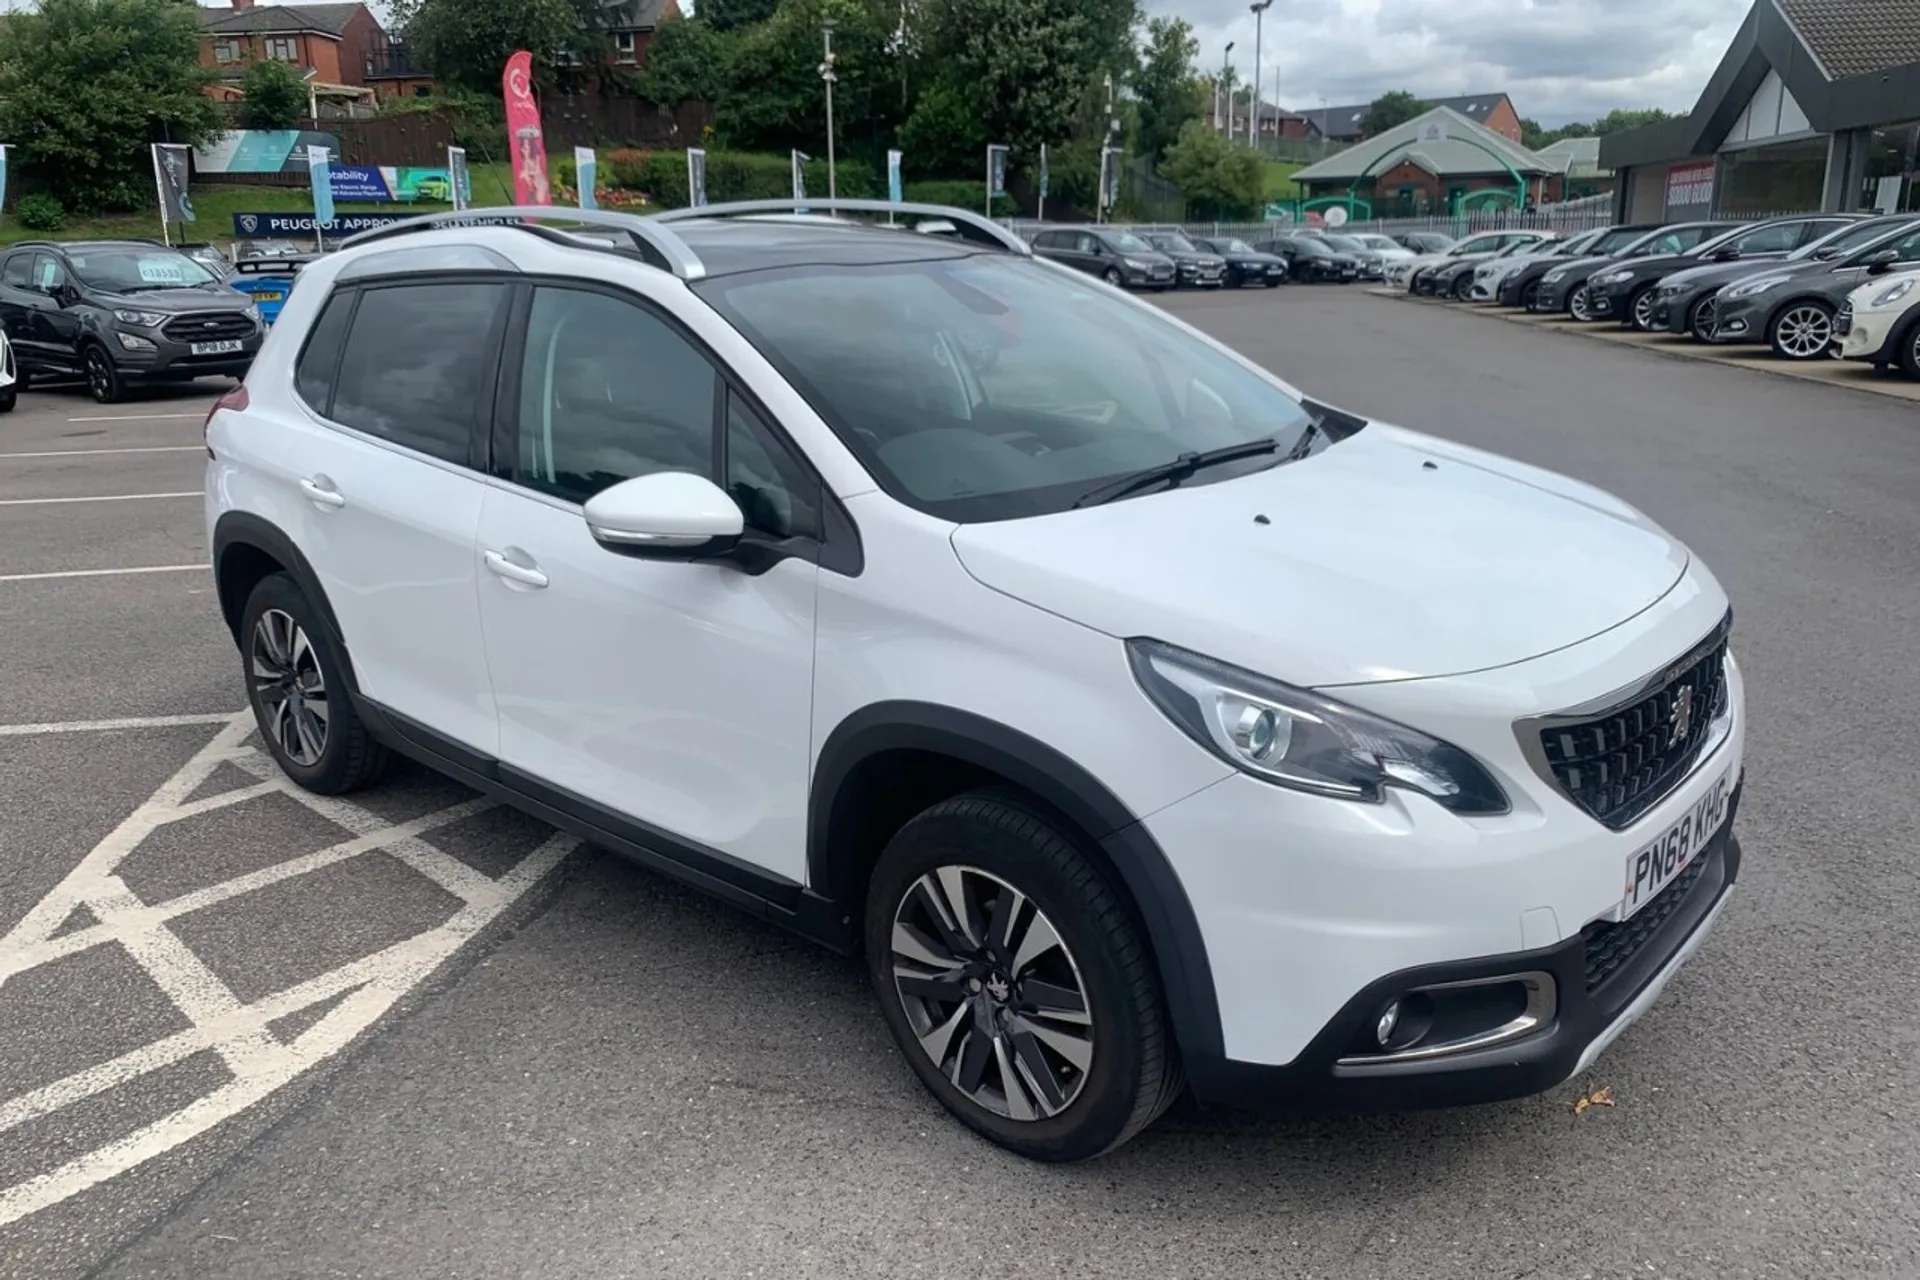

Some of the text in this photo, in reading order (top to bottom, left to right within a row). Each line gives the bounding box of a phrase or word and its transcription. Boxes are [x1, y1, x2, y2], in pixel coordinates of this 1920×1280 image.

[271, 218, 340, 230] PEUGEOT
[1633, 778, 1726, 904] PN68 KHG
